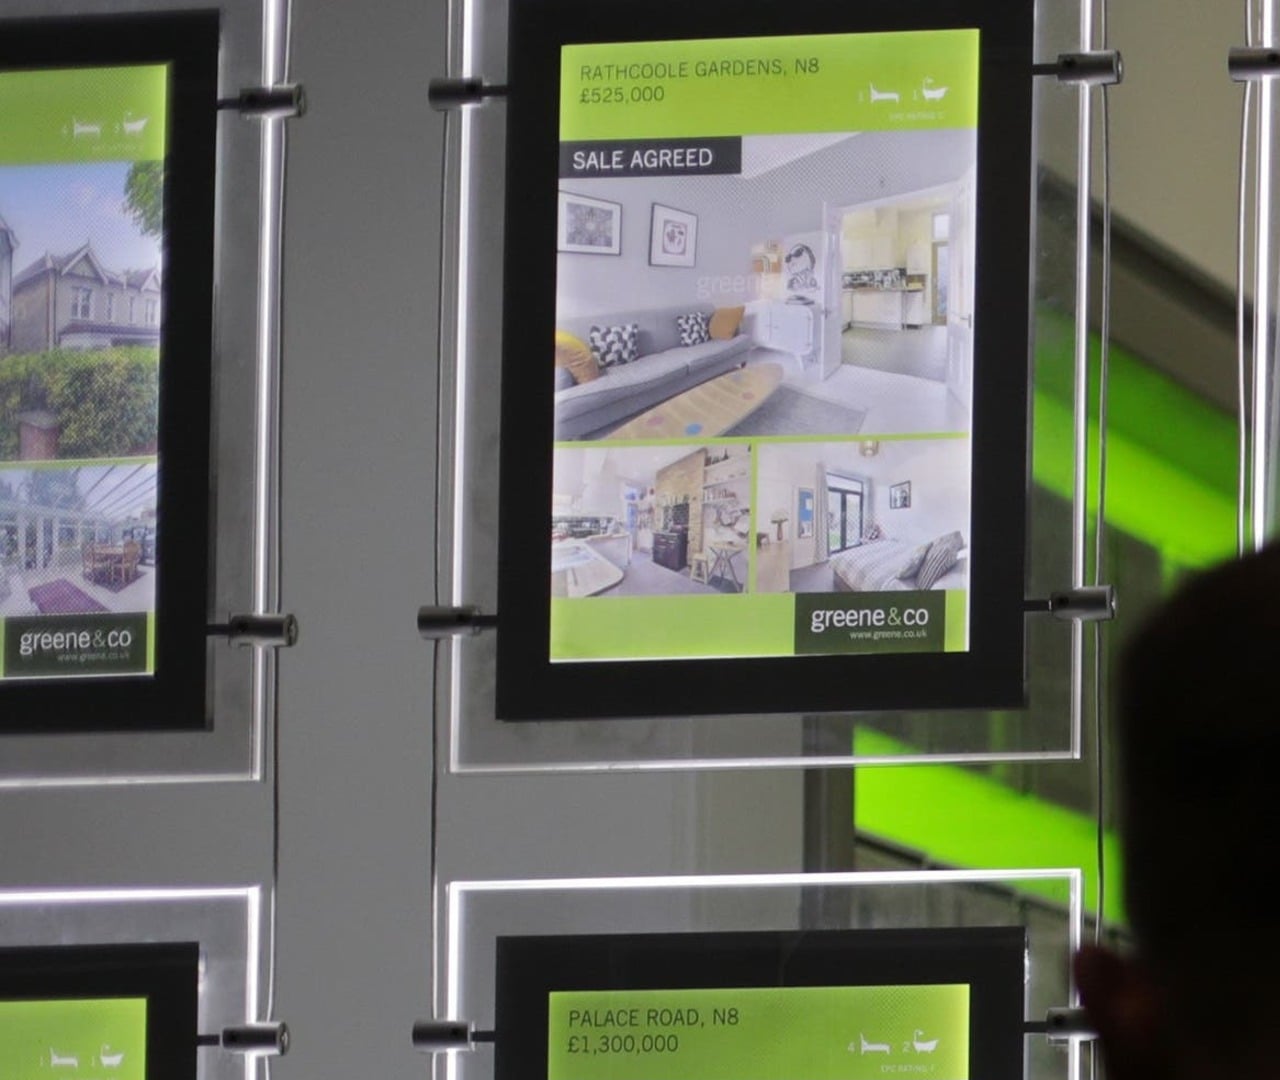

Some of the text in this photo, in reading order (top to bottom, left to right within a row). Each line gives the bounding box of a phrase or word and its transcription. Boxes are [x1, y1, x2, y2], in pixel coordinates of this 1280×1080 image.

[579, 57, 820, 81] RATHCOOLE GARDENS, N8
[579, 86, 665, 105] £525,000
[572, 148, 713, 170] SALE AGREED
[569, 1007, 739, 1028] PALACE ROAD, N8
[568, 1034, 679, 1055] £1,300,000
